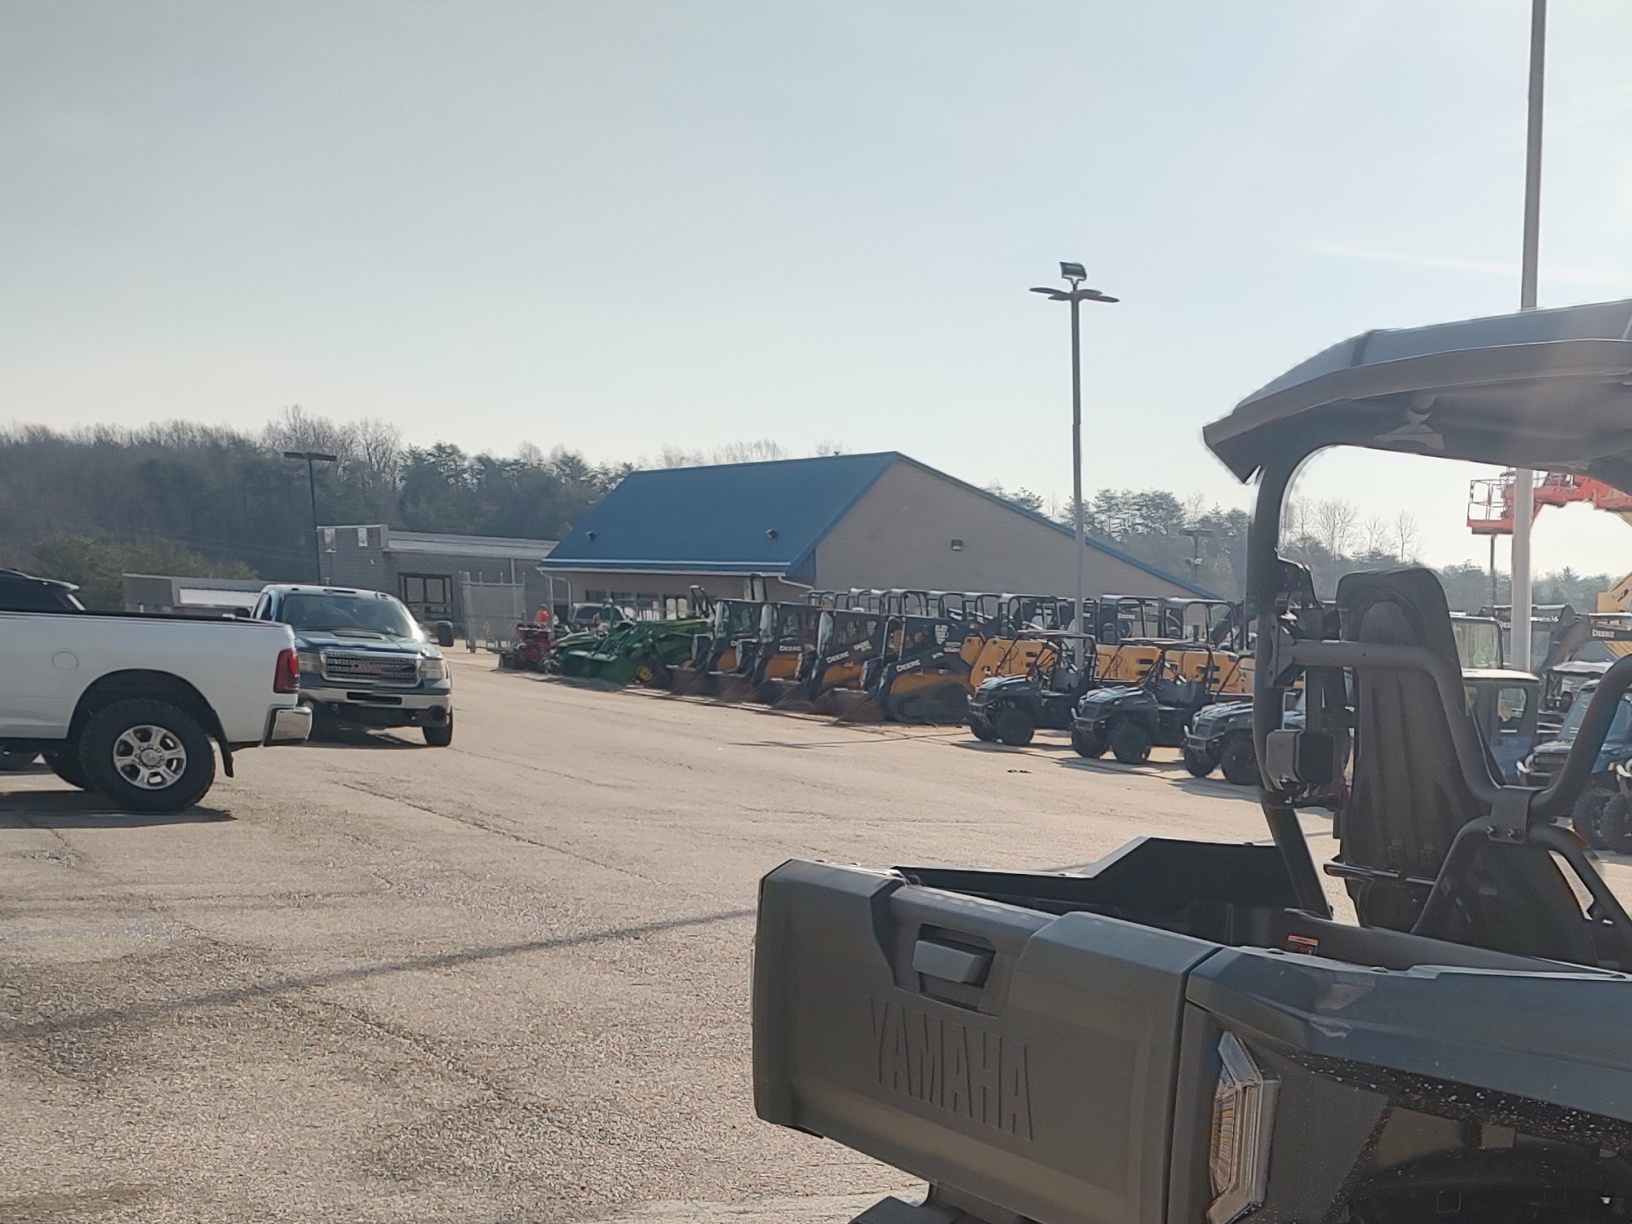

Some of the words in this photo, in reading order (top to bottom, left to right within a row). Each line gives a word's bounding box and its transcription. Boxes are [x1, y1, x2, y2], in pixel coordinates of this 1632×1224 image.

[1592, 629, 1615, 638] DEERE
[826, 651, 849, 663] DEERE
[896, 660, 921, 672] DEERE
[869, 995, 1034, 1142] YAMAHA
